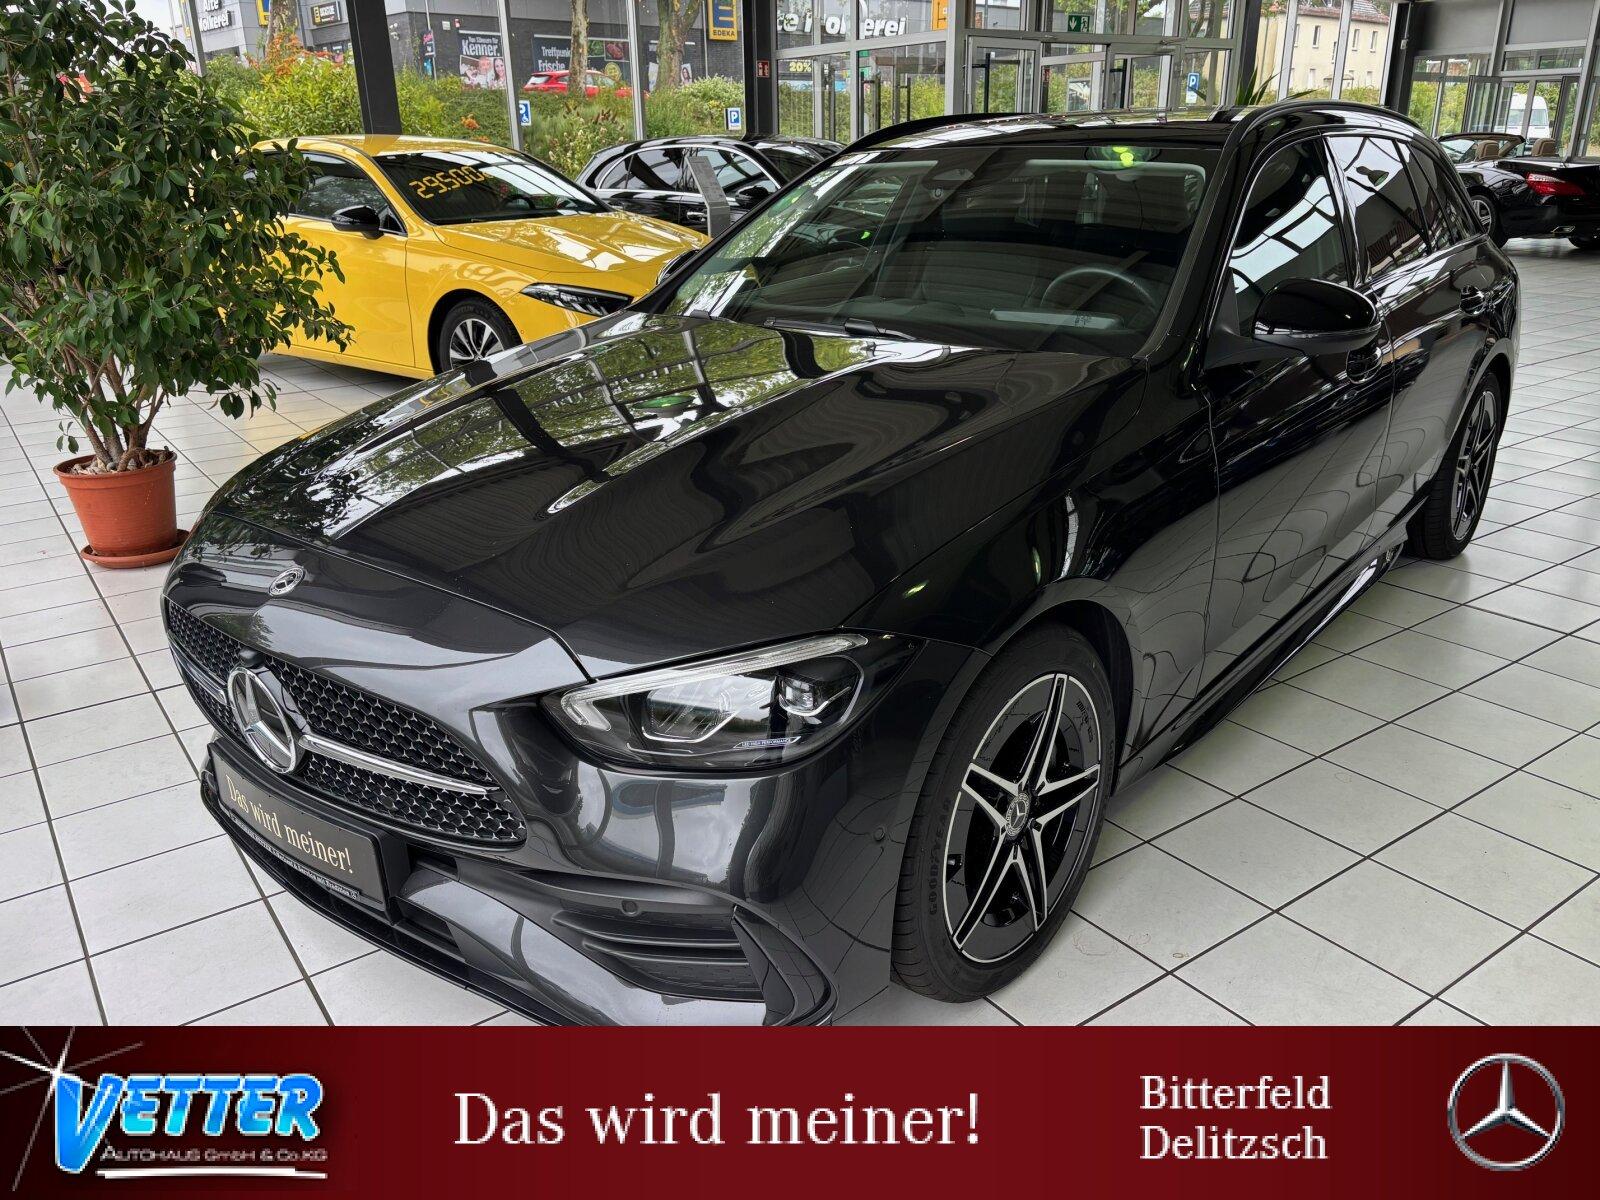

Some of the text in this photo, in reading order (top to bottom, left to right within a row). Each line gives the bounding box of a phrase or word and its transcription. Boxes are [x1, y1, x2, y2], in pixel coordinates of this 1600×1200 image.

[712, 29, 735, 37] EDEKA
[462, 39, 500, 56] Kenner.
[541, 45, 571, 59] Treffpunk
[537, 59, 566, 72] Frische
[789, 61, 812, 72] 20%
[731, 111, 738, 122] P
[226, 774, 249, 813] Das
[249, 801, 282, 839] wird
[284, 824, 353, 874] meiner!
